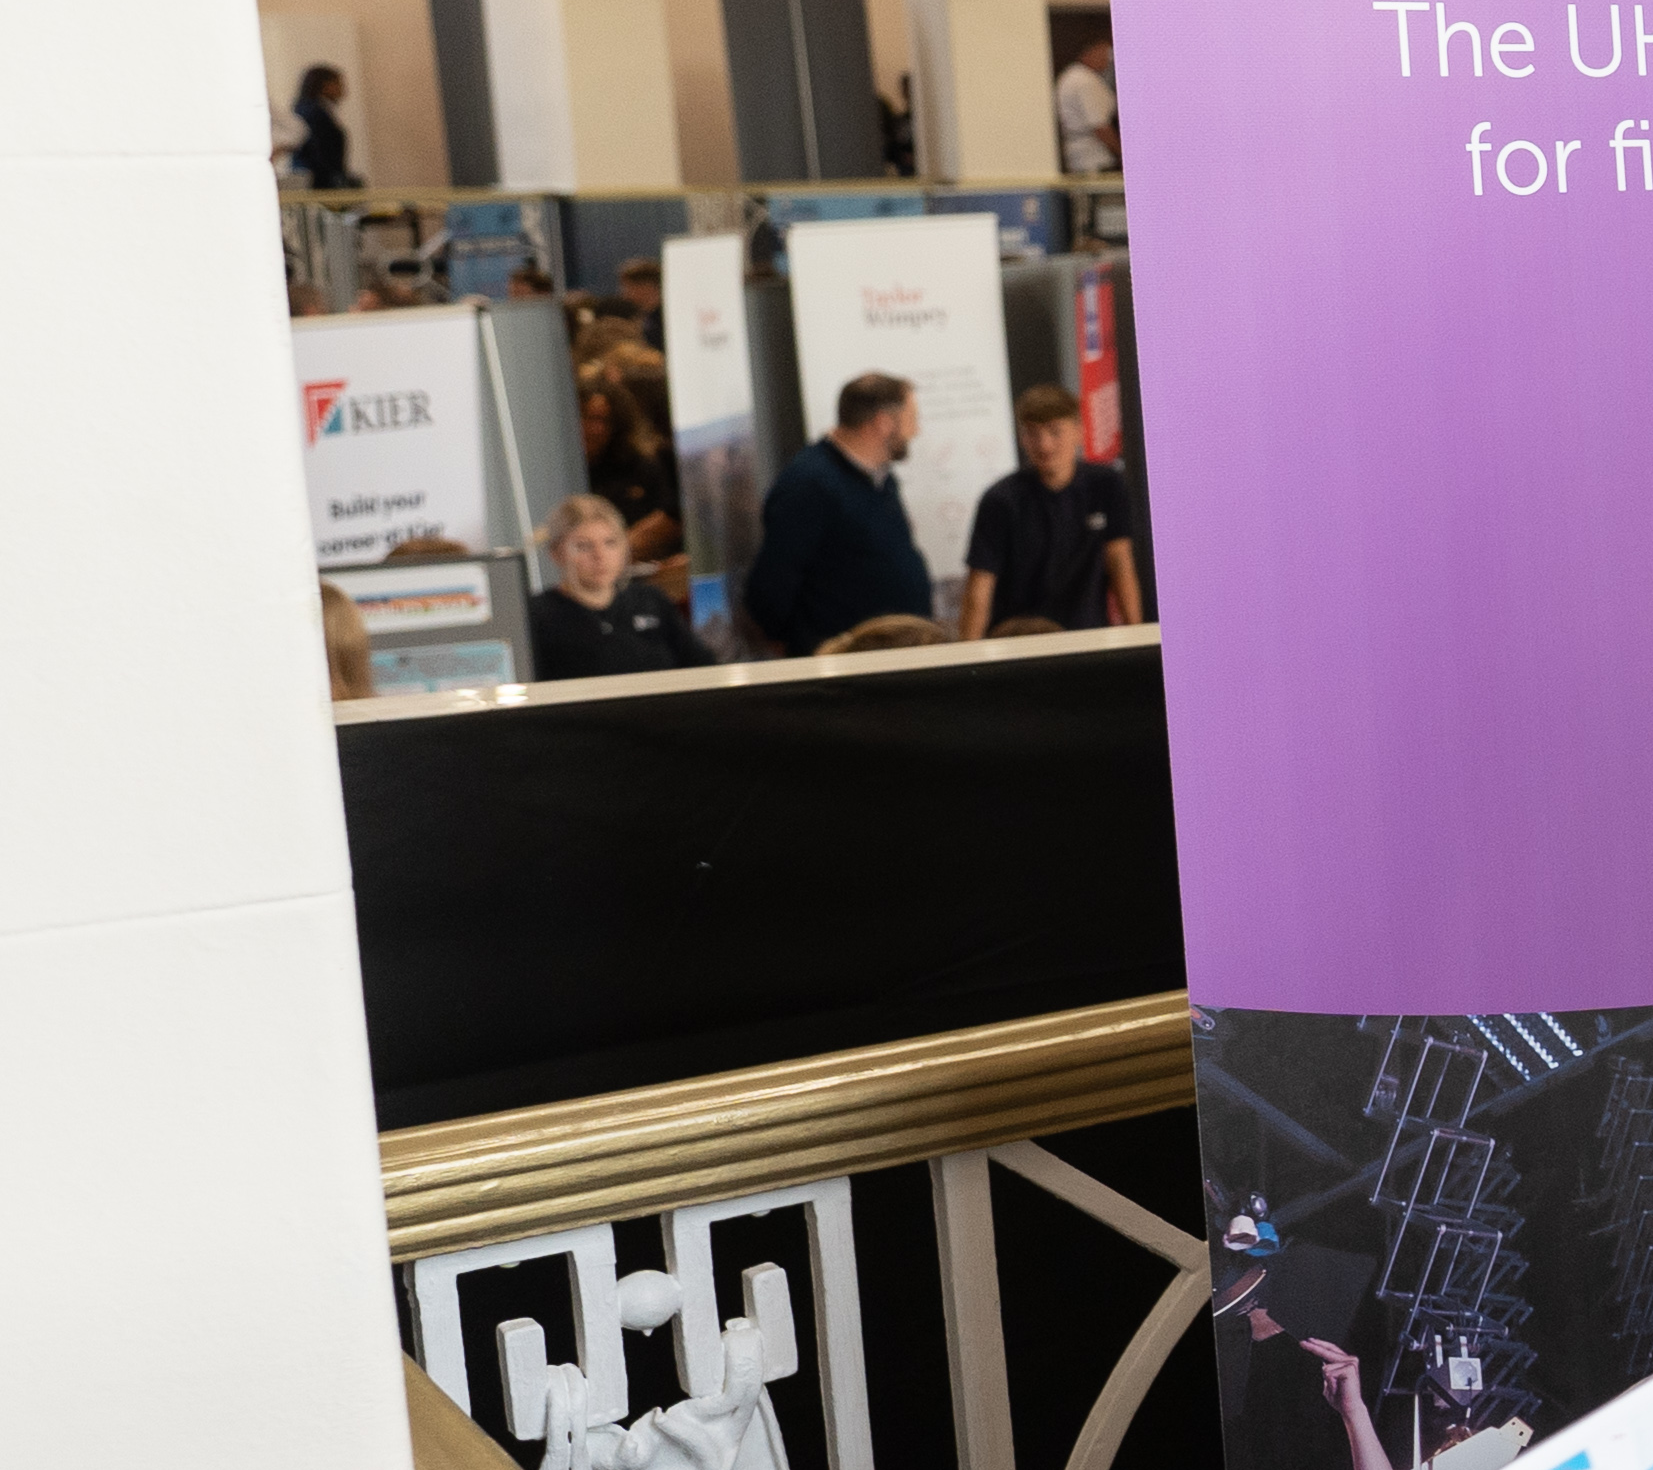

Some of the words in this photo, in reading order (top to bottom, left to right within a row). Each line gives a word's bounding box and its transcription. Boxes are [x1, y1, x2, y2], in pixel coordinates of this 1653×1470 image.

[1373, 0, 1536, 79] The
[1465, 122, 1582, 196] for
[350, 390, 432, 432] KIER
